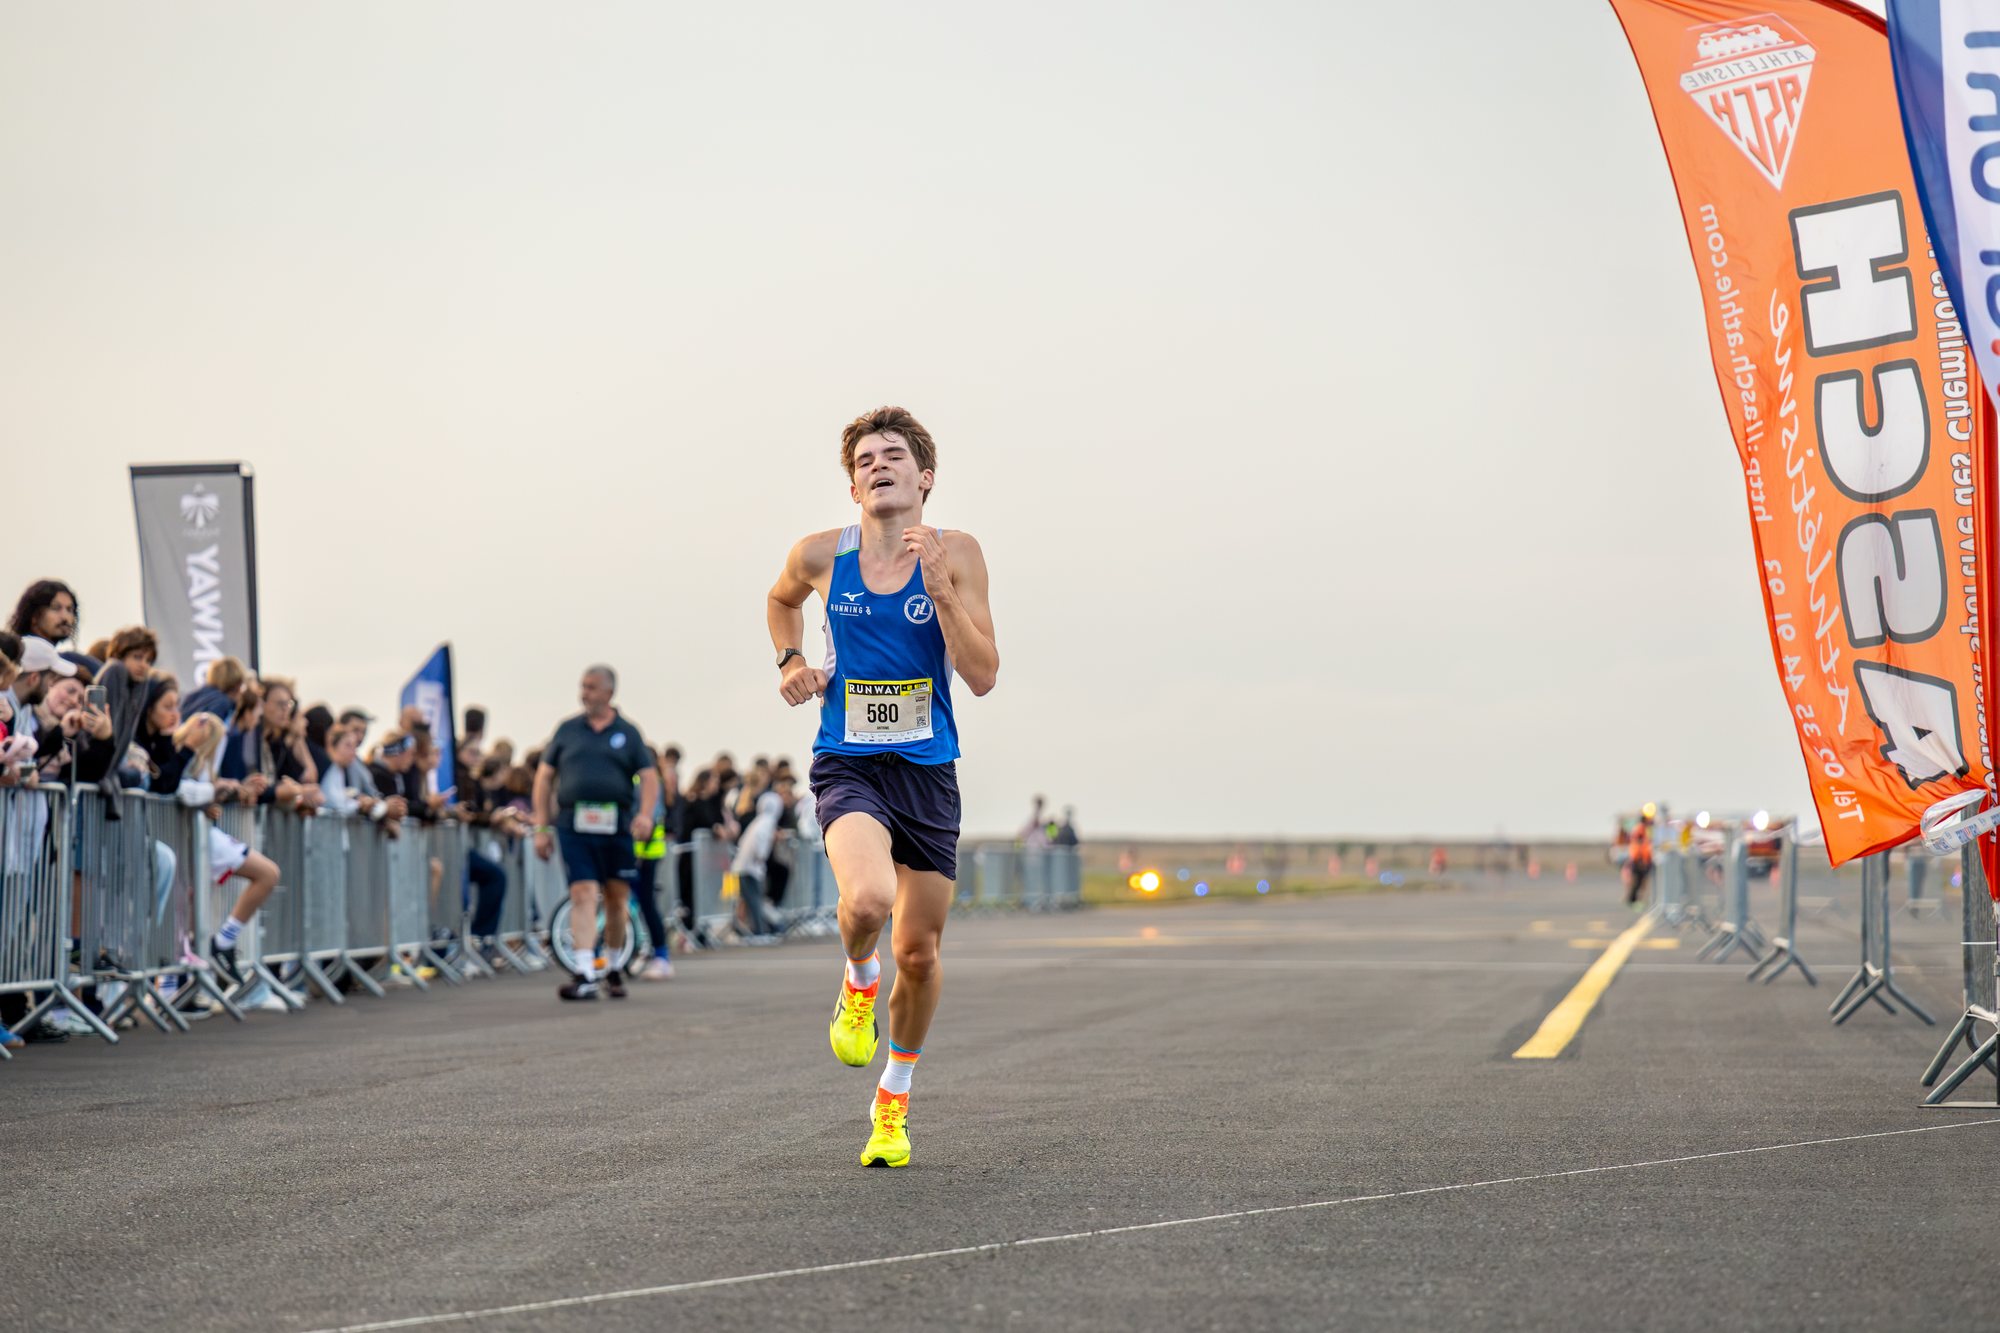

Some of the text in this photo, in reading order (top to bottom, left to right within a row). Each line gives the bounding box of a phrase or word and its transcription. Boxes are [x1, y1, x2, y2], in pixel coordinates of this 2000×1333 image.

[830, 603, 863, 614] RUNNING
[848, 683, 900, 695] RUNWAY
[867, 703, 899, 724] 580
